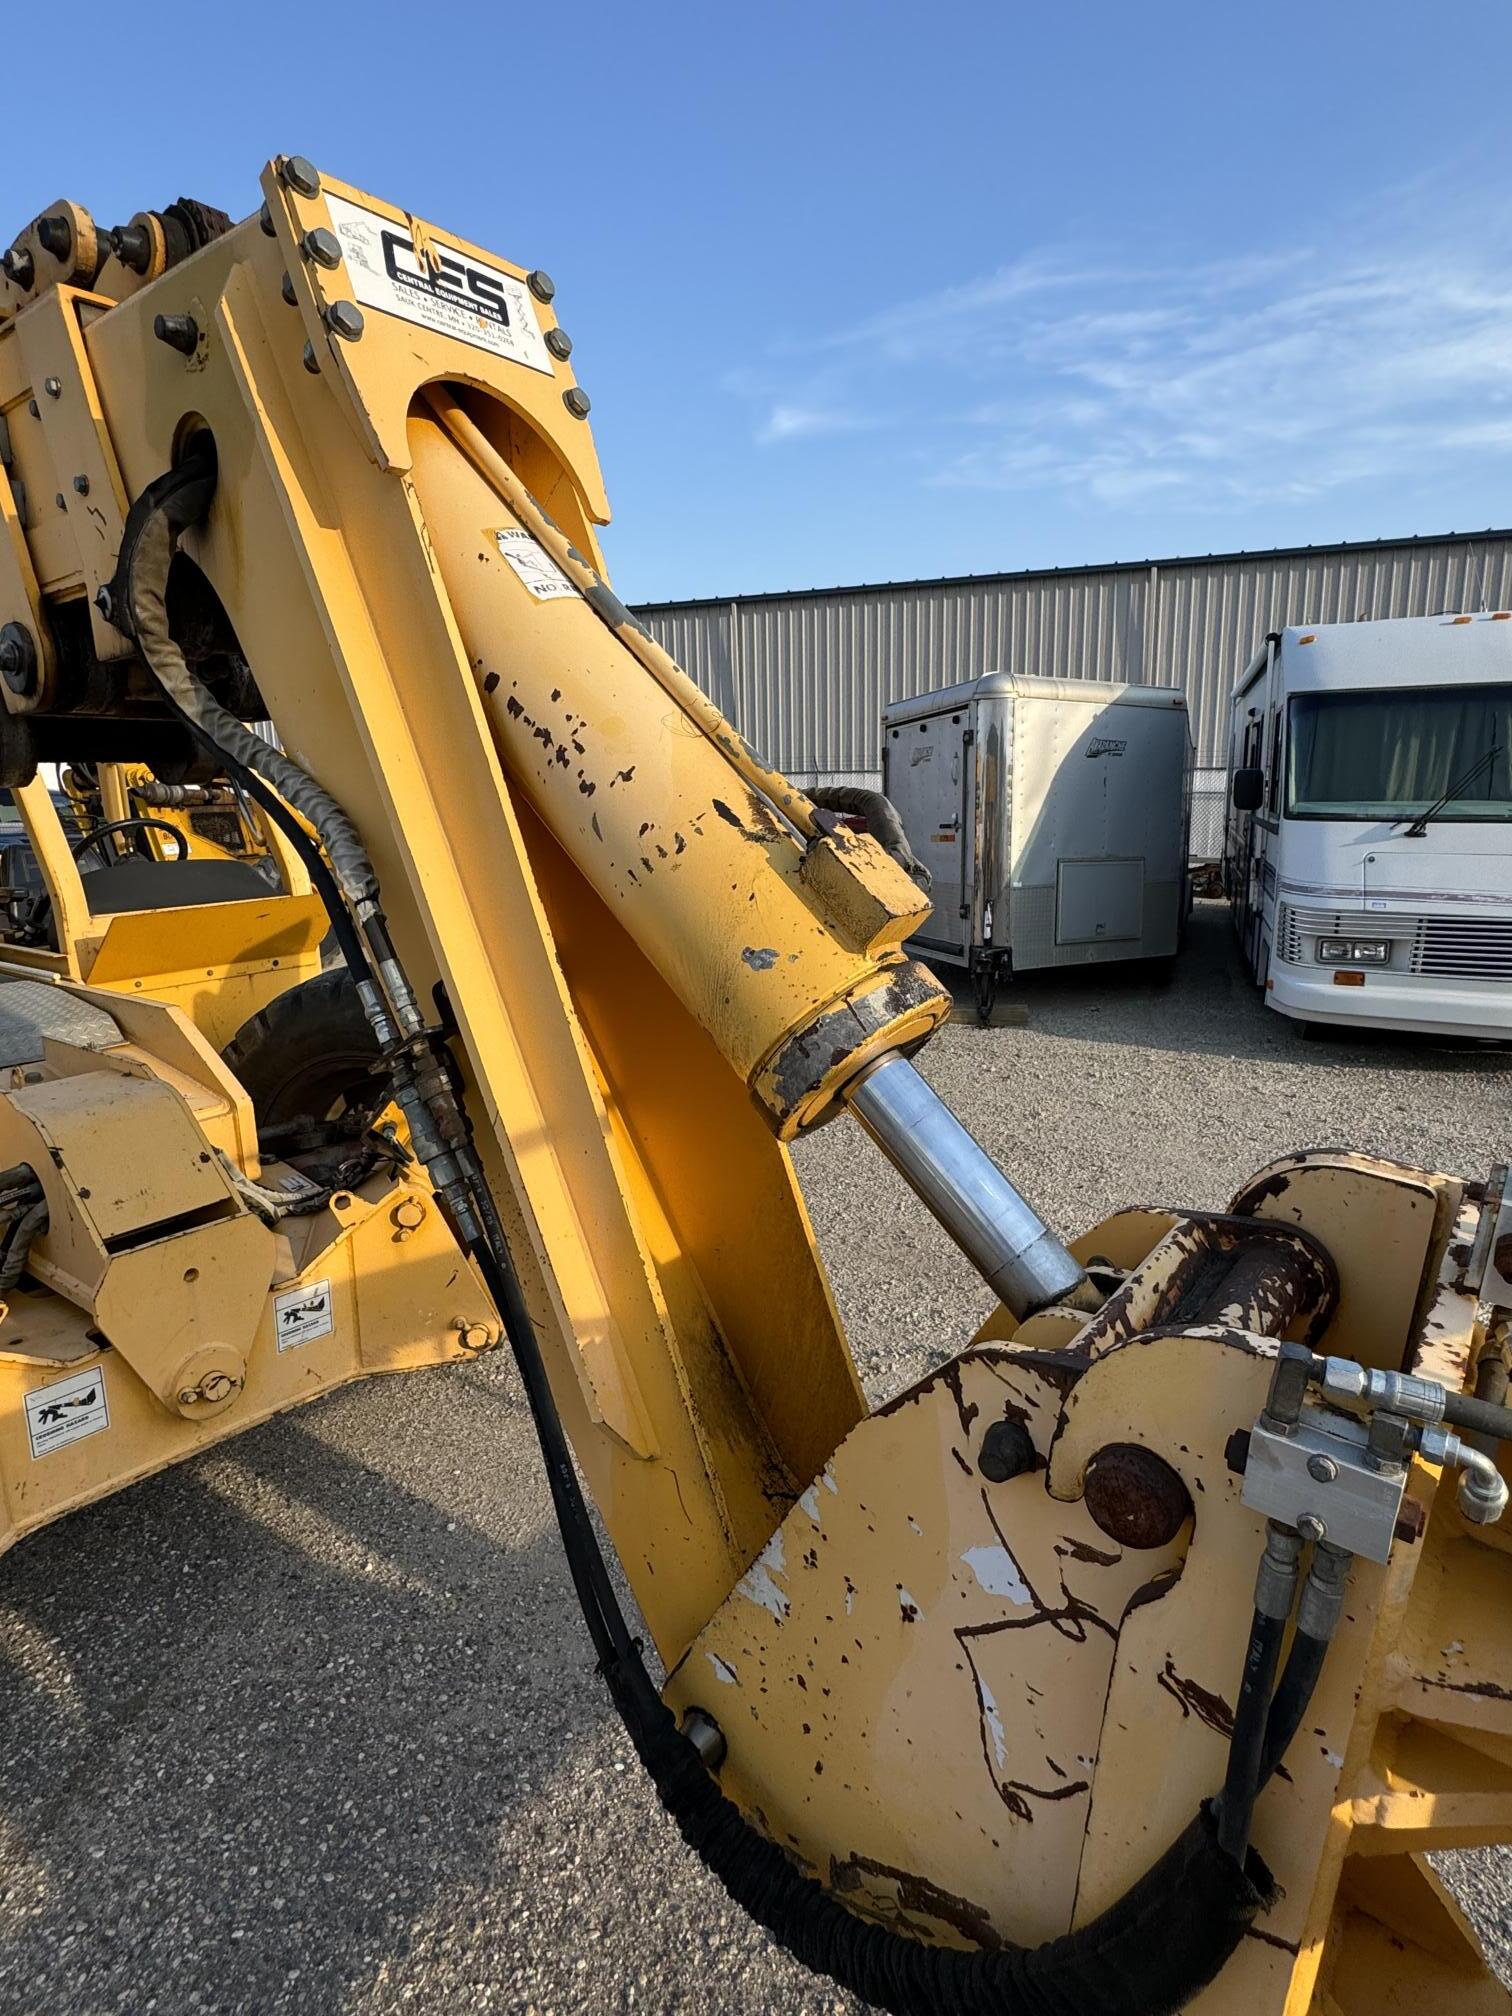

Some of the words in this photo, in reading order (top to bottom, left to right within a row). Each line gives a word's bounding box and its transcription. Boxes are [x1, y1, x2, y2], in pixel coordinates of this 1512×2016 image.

[381, 230, 510, 327] CES
[396, 271, 434, 293] CENTRAL
[434, 286, 478, 311] EQUIPMENT
[479, 305, 503, 321] SALES
[392, 282, 421, 301] SALES
[430, 297, 468, 319] SERVICE
[475, 316, 512, 337] RNTALS
[534, 583, 557, 594] NO
